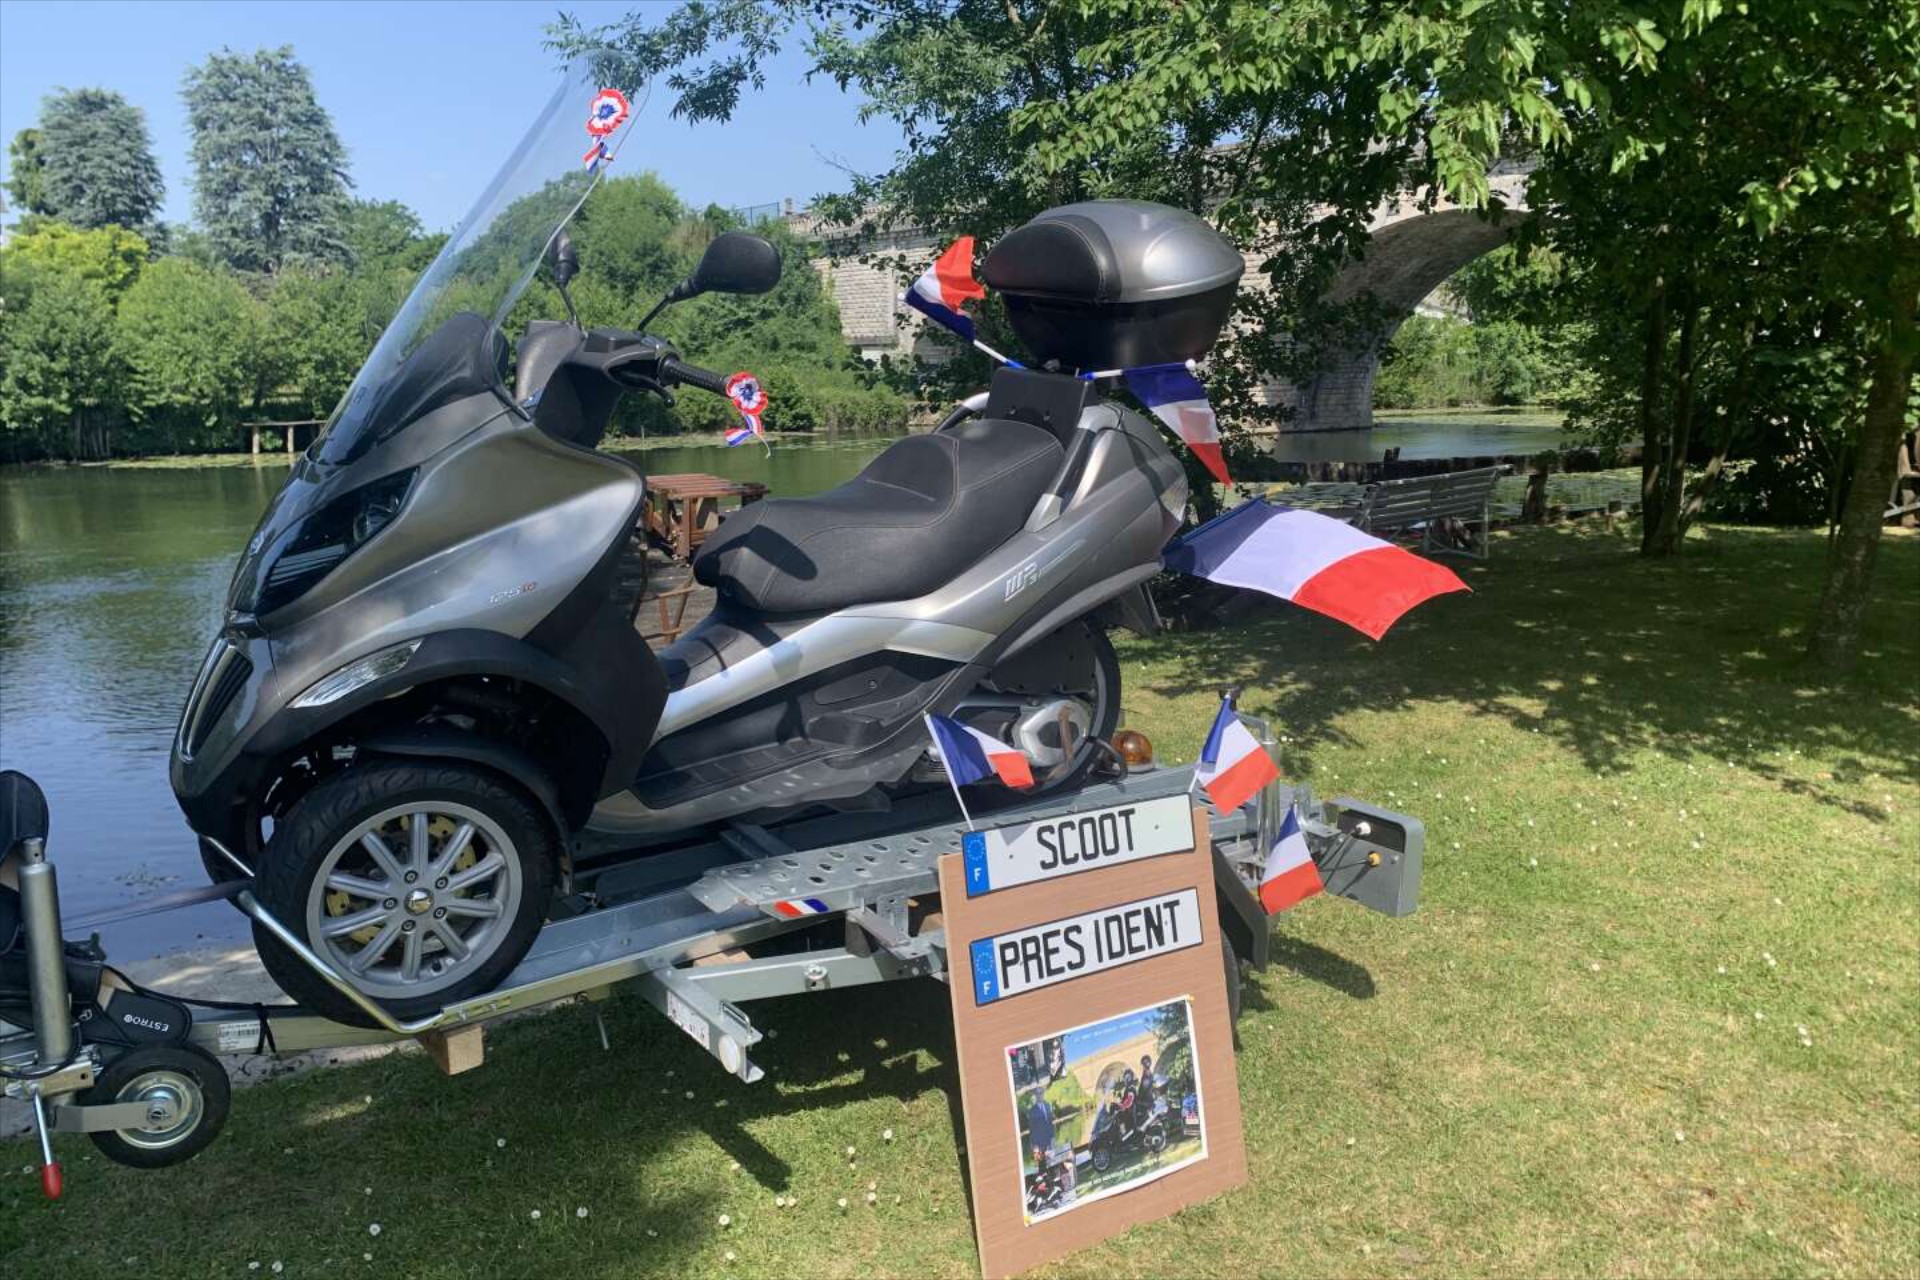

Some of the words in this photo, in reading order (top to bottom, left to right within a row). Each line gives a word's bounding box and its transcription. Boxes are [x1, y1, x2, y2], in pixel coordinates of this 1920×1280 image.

[1036, 808, 1135, 870] SCOOT
[973, 867, 982, 882] F
[983, 981, 991, 996] F
